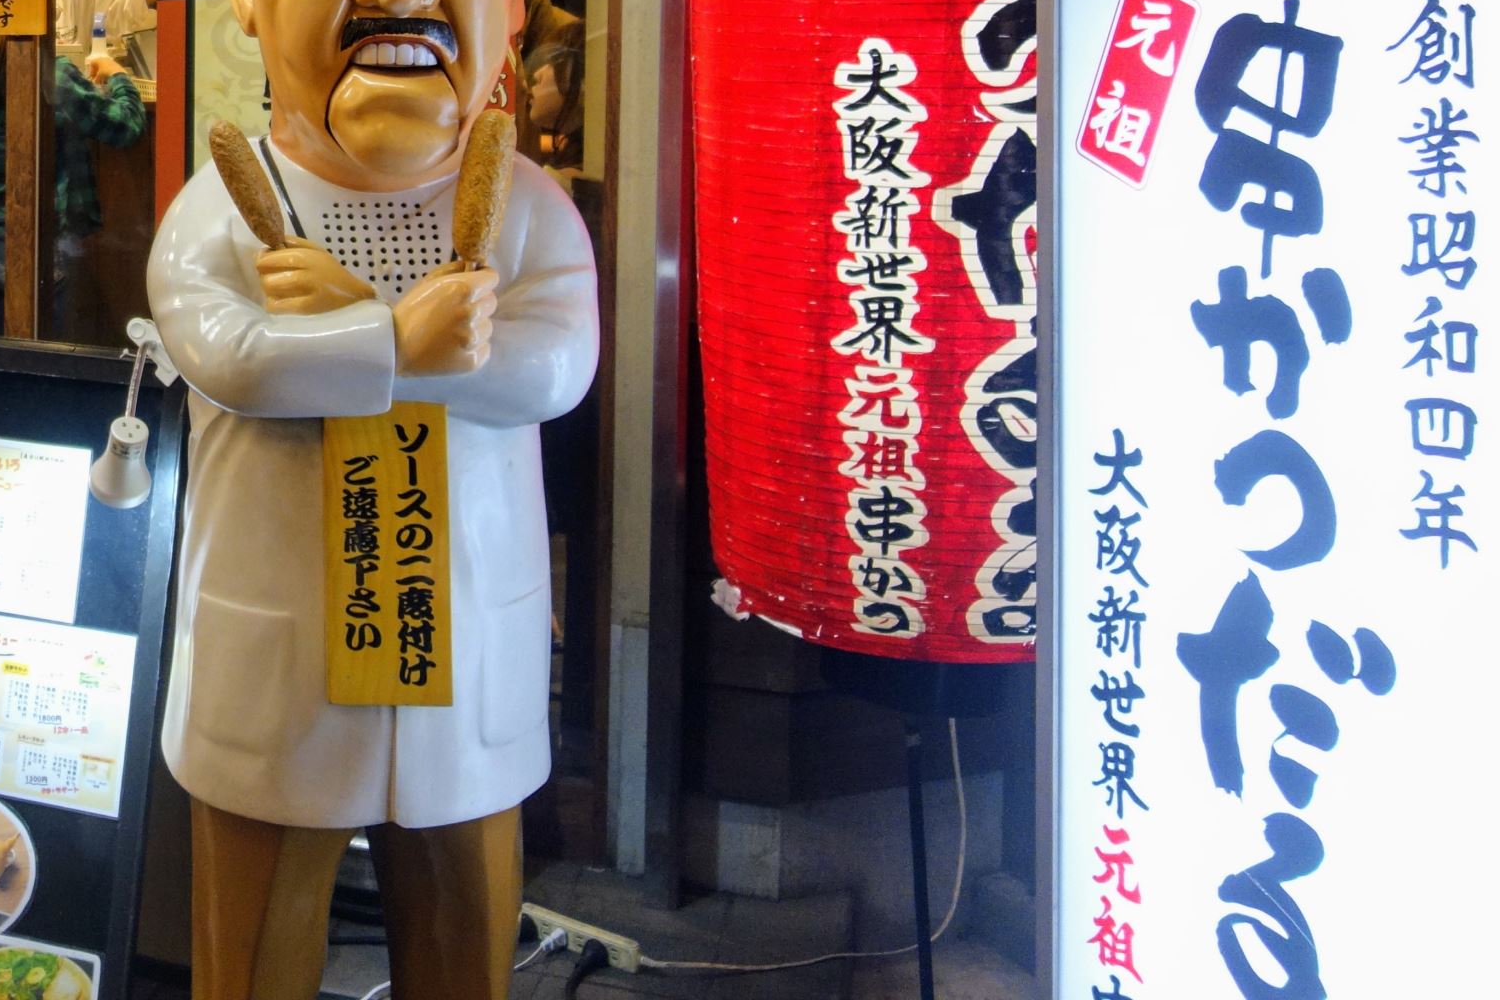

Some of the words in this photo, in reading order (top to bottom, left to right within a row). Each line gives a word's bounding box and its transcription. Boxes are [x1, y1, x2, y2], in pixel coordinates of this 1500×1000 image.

[1088, 0, 1175, 168] 元祖
[838, 46, 924, 636] 大阪新世界元祖串かつ
[342, 454, 382, 651] ご遠慮下さい
[394, 423, 437, 687] ソースの二度付け
[1086, 428, 1150, 1000] 大阪新世界元祖
